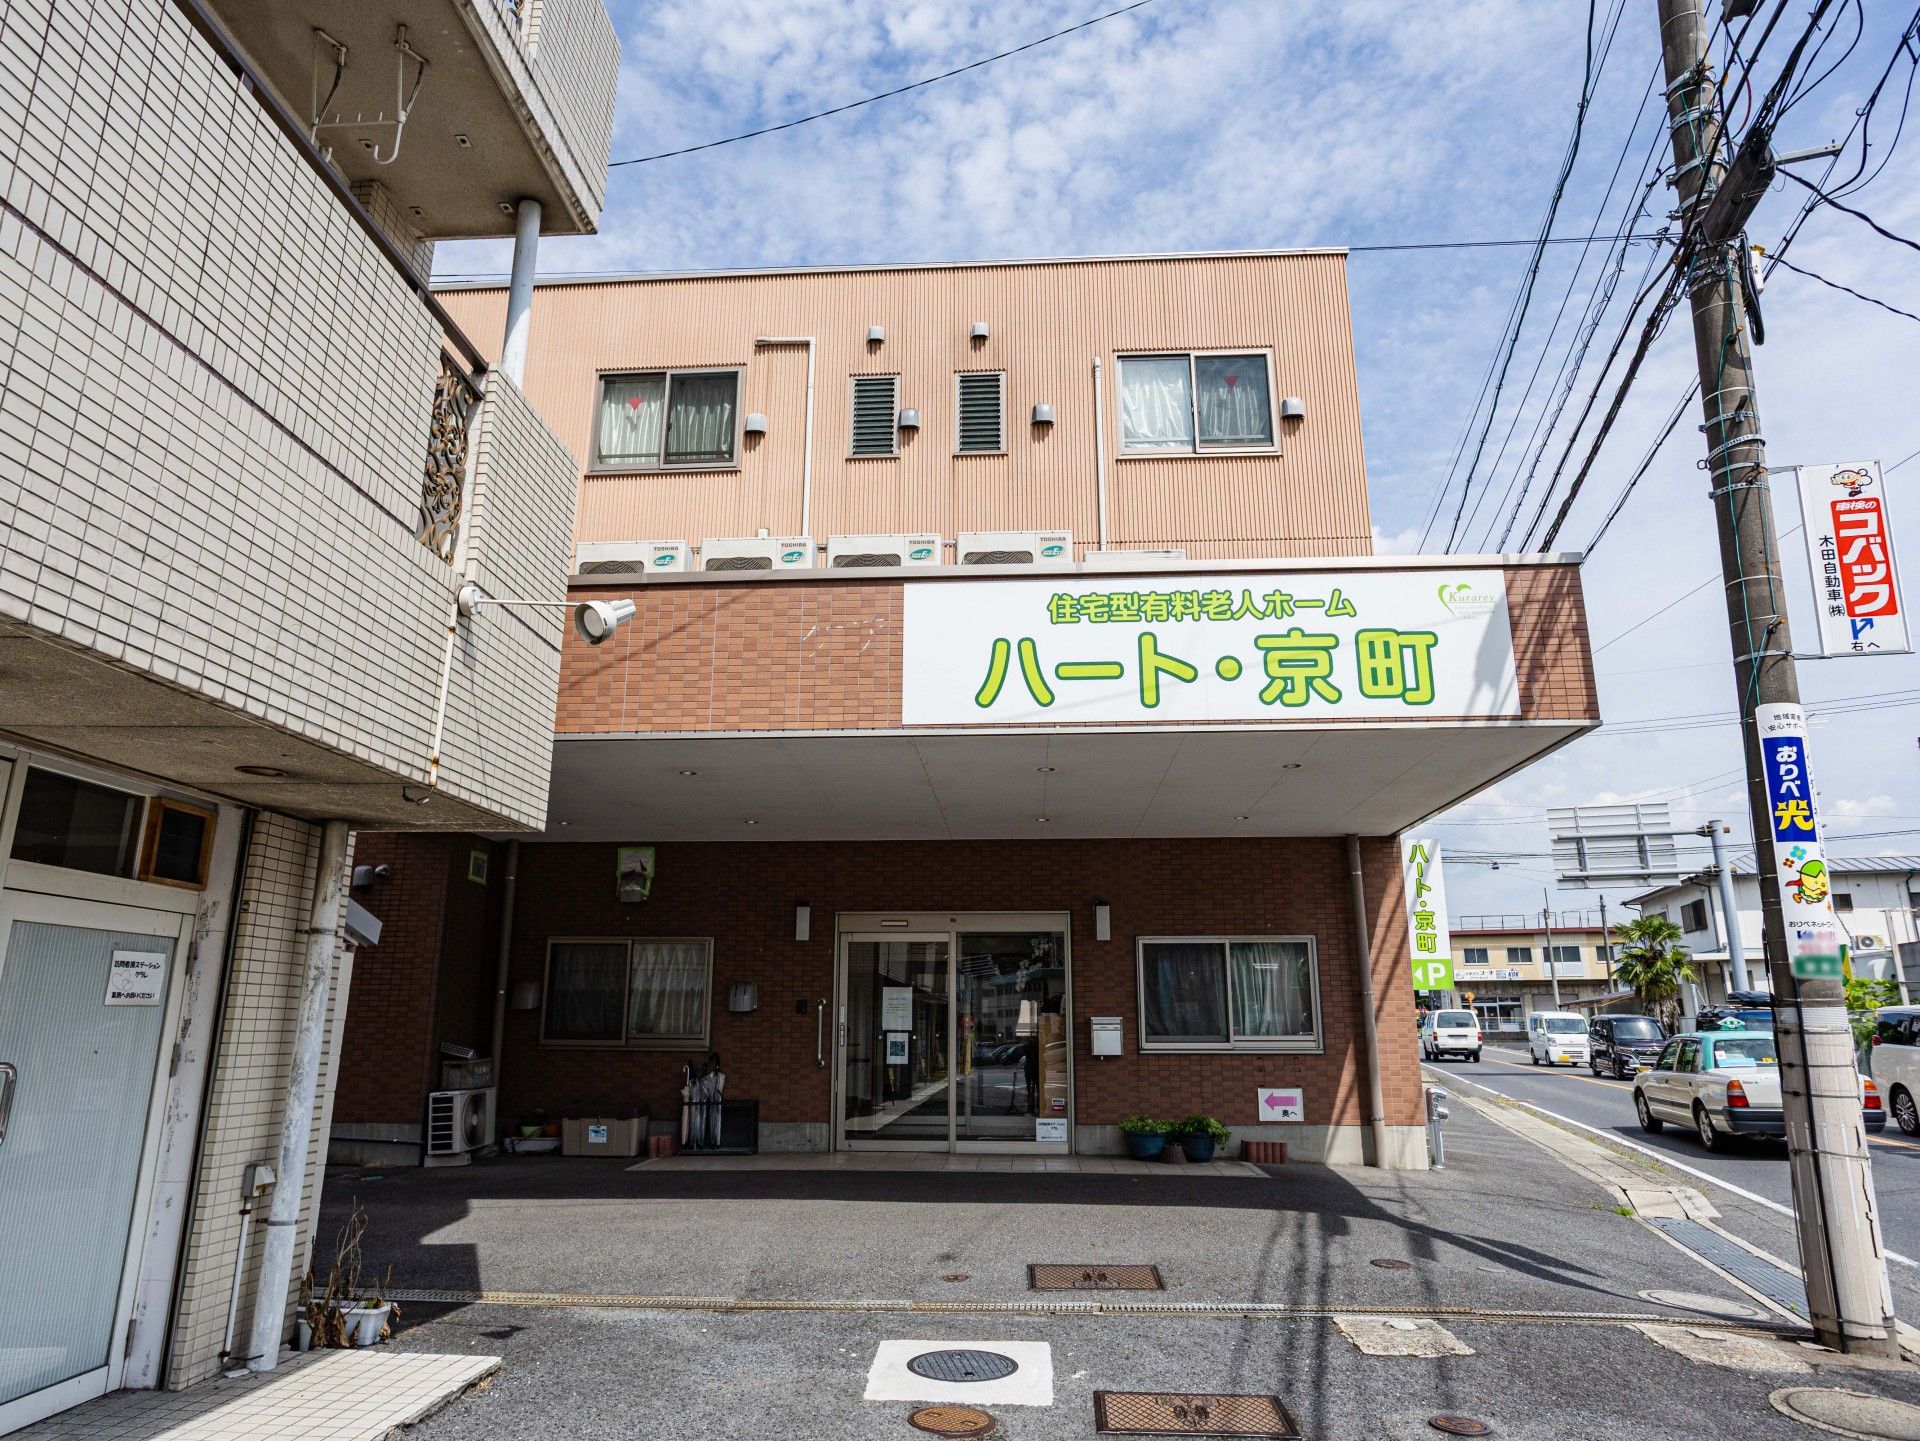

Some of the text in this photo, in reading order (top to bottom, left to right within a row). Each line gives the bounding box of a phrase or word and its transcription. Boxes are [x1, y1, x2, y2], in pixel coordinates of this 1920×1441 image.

[1836, 501, 1877, 511] 車検の
[1839, 512, 1890, 614] コバック
[1047, 589, 1357, 624] 住宅型有料老人ホーム
[1851, 640, 1880, 651] 右へ
[975, 627, 1438, 708] ハート・京町
[1775, 746, 1815, 830] おりべ光
[1409, 845, 1437, 953] ハート・京町
[1427, 962, 1445, 986] P
[1282, 1109, 1298, 1118] 奥へ
